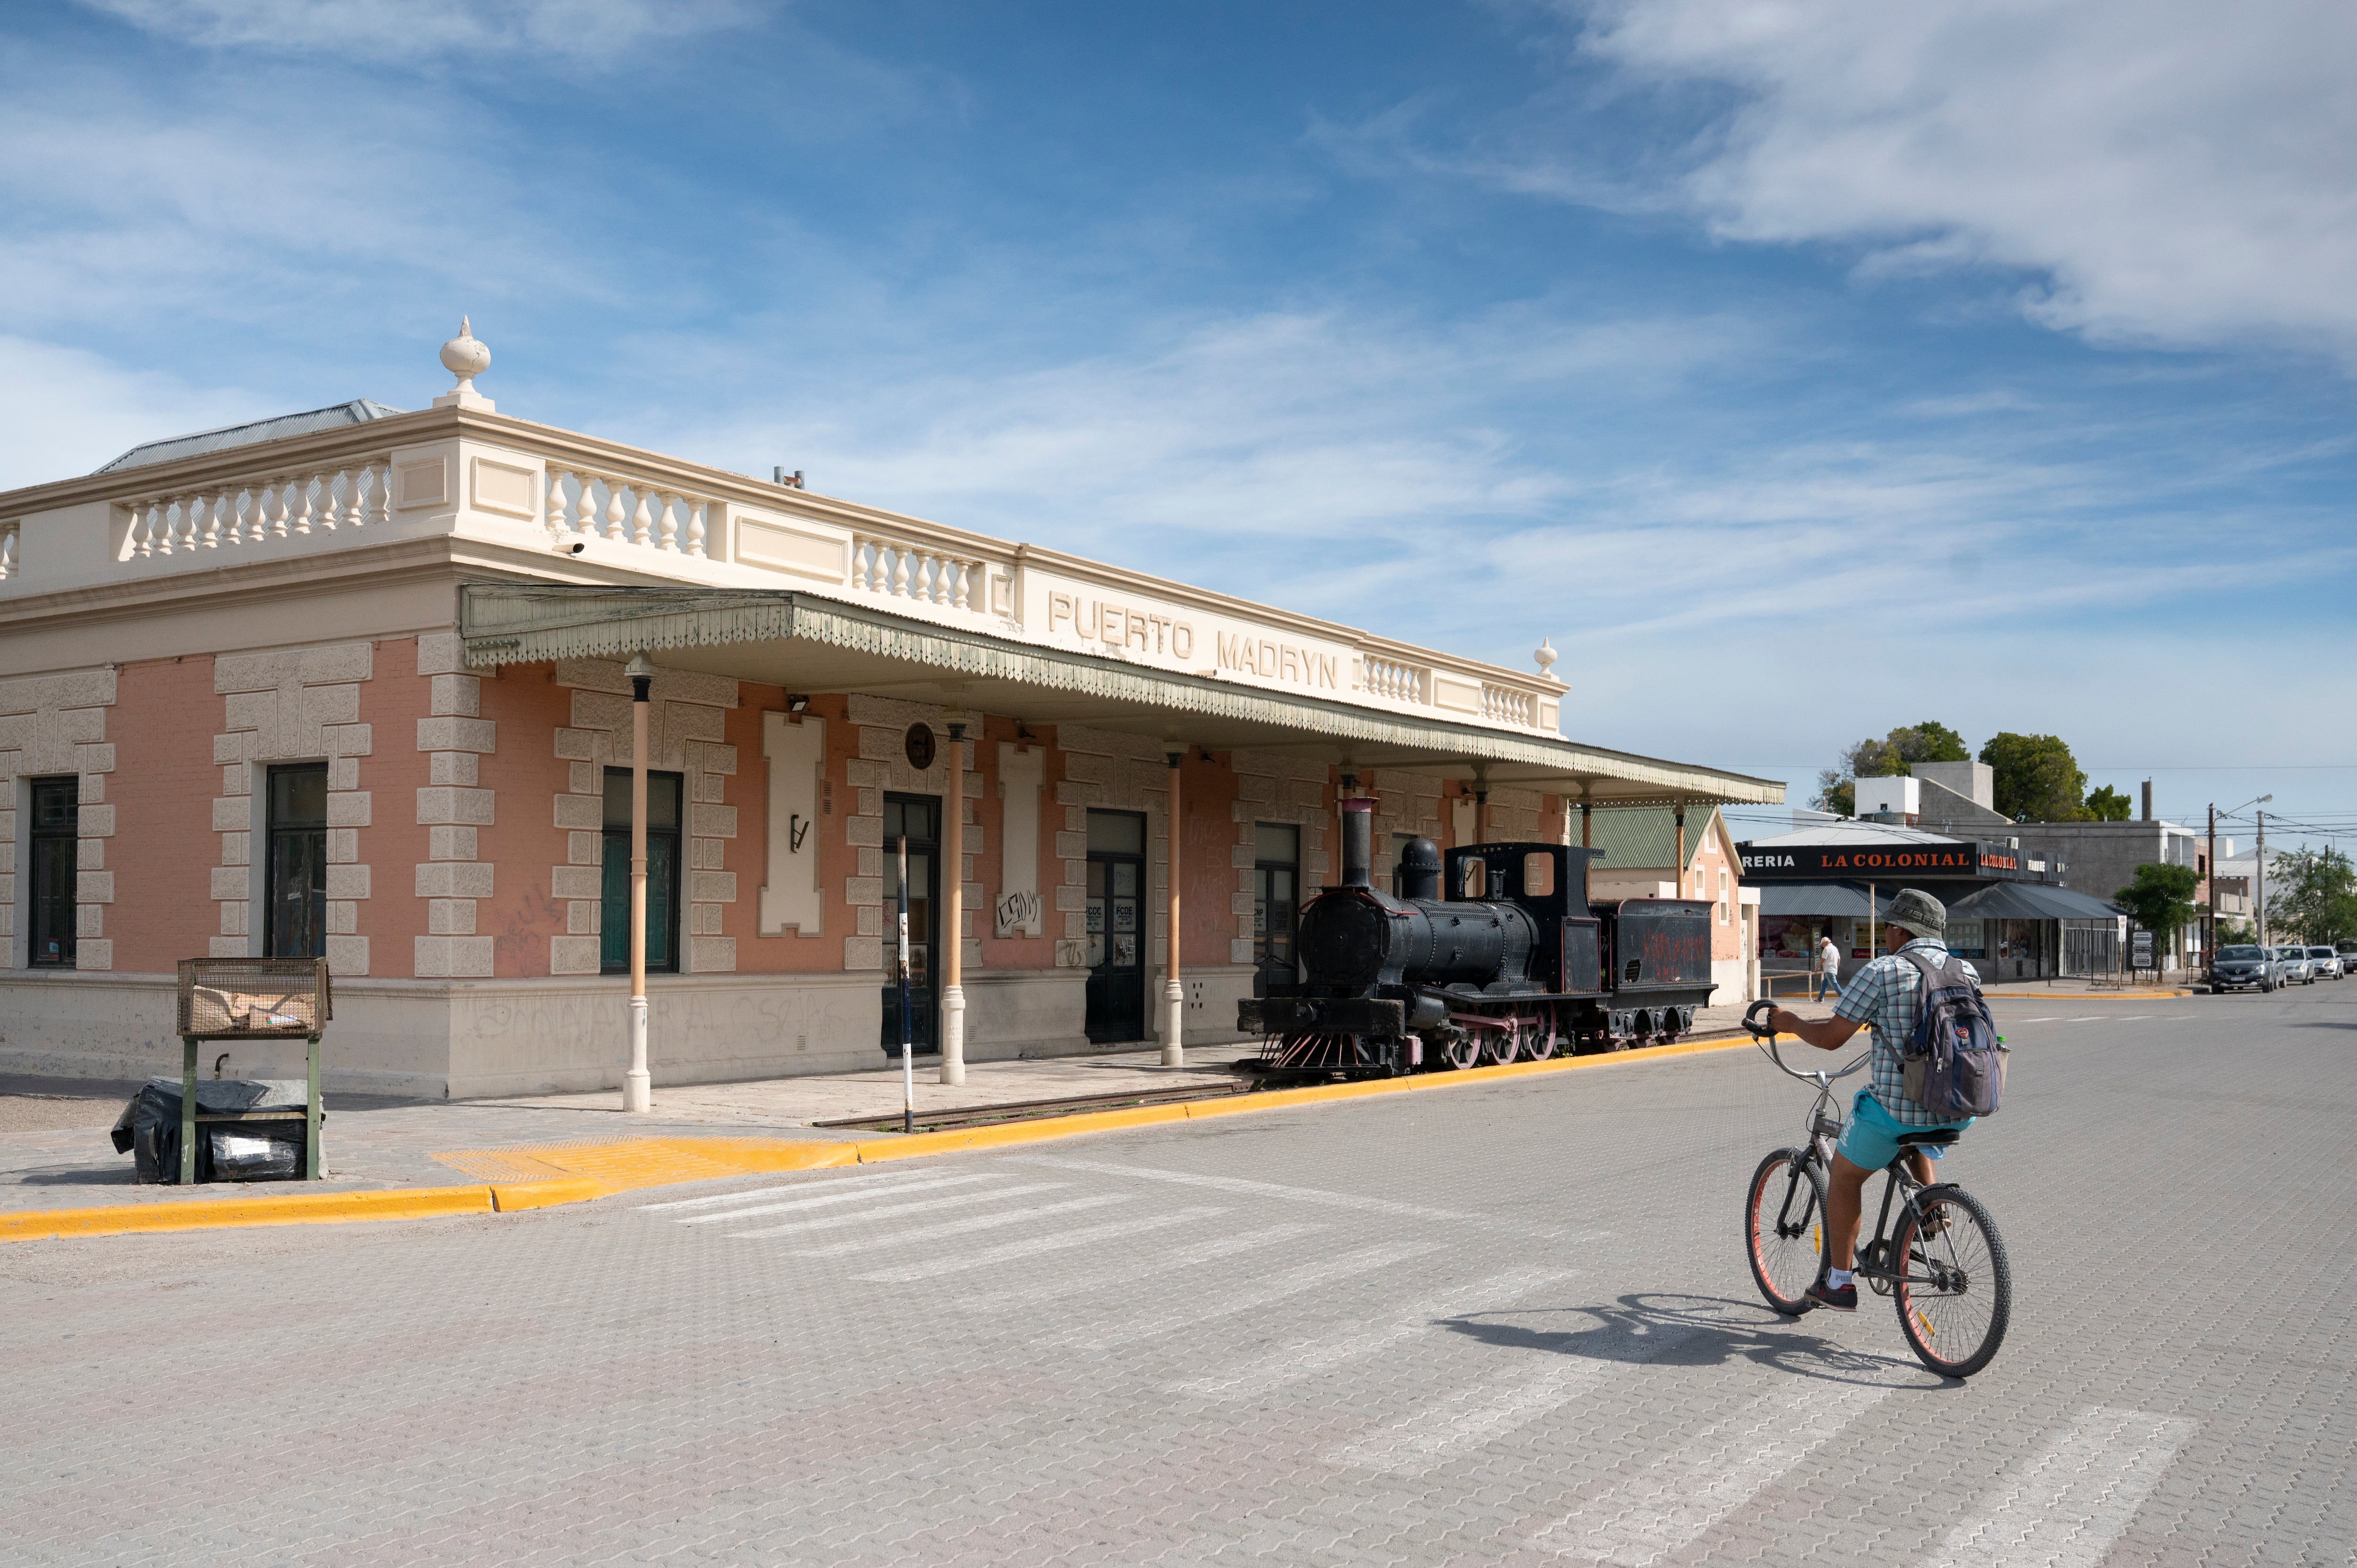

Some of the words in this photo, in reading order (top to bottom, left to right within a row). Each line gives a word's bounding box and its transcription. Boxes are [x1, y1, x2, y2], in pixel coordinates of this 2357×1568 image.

[1049, 590, 1194, 659] PUERTO
[1218, 630, 1338, 689] MADRYN
[1742, 855, 1795, 867] RERIA
[1821, 854, 1848, 867] LA
[1854, 853, 1970, 867] COLONIAL
[1980, 854, 1989, 866] LA
[1989, 854, 2017, 870] COLONIAL
[1116, 906, 1132, 915] FCDE
